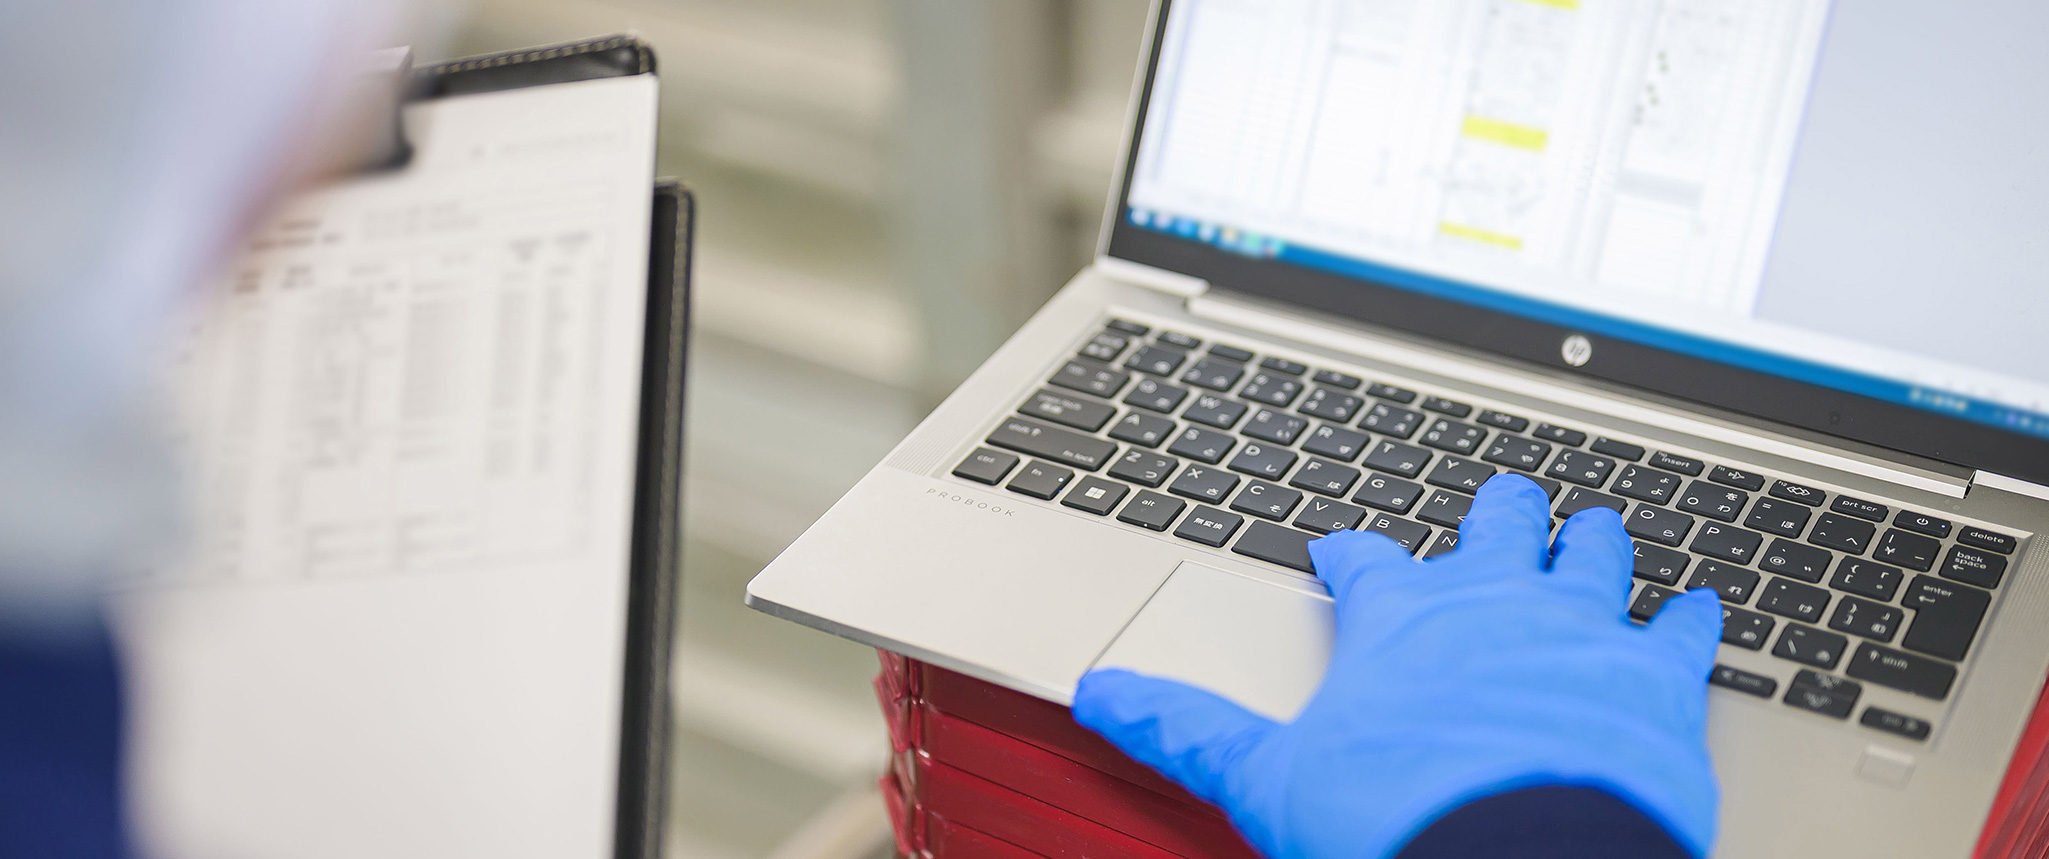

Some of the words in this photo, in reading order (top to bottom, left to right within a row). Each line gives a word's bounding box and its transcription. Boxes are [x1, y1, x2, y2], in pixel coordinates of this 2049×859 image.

[1126, 414, 1139, 425] A
[1185, 429, 1199, 440] S
[1318, 427, 1333, 438] R
[1245, 445, 1260, 455] D
[1384, 443, 1395, 453] T
[977, 455, 995, 464] ctrl
[1074, 453, 1094, 463] lock
[1126, 452, 1141, 462] Z
[1308, 462, 1321, 470] F
[1448, 460, 1459, 469] Y
[1661, 457, 1690, 468] insert
[1187, 468, 1202, 478] X
[1556, 464, 1567, 472] 8
[1371, 479, 1385, 488] G
[1621, 480, 1632, 488] 9
[1251, 486, 1264, 494] C
[1434, 495, 1449, 505] H
[1572, 492, 1579, 500] I
[926, 487, 1016, 517] PROBOOK
[1317, 502, 1328, 511] V
[1640, 510, 1654, 519] O
[1376, 519, 1390, 528] B
[1441, 536, 1458, 547] N
[1971, 532, 2004, 543] delete
[1634, 547, 1644, 557] L
[1956, 551, 1983, 563] back
[1770, 557, 1785, 565] @
[1954, 557, 1987, 570] space
[1923, 585, 1953, 597] enter
